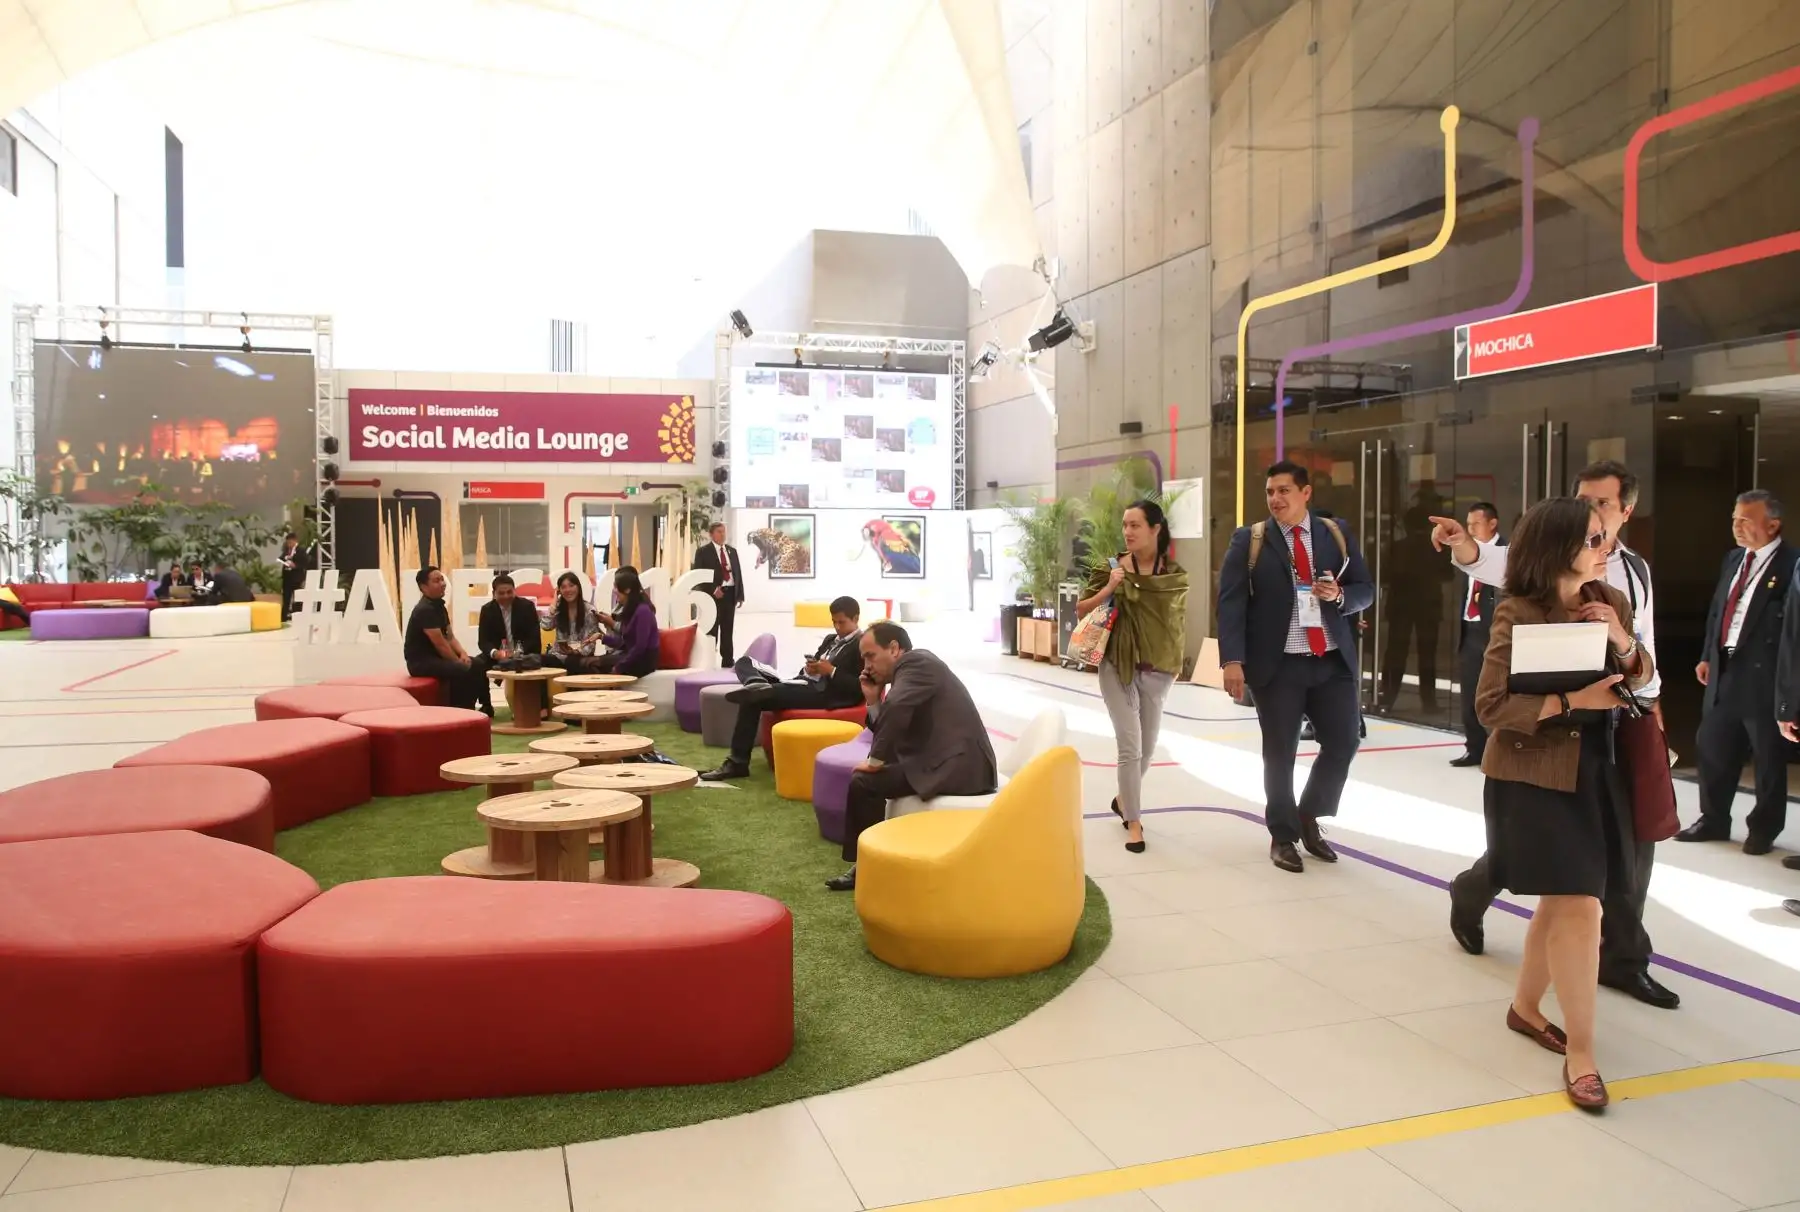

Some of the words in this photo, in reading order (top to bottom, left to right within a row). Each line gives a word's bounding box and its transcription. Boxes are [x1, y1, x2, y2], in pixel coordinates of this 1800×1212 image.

[1474, 332, 1534, 359] MOCHICA
[361, 403, 417, 416] Welcome
[426, 404, 499, 418] Bienvenidos
[361, 424, 447, 449] Social
[452, 425, 531, 450] Media
[537, 427, 629, 457] Lounge
